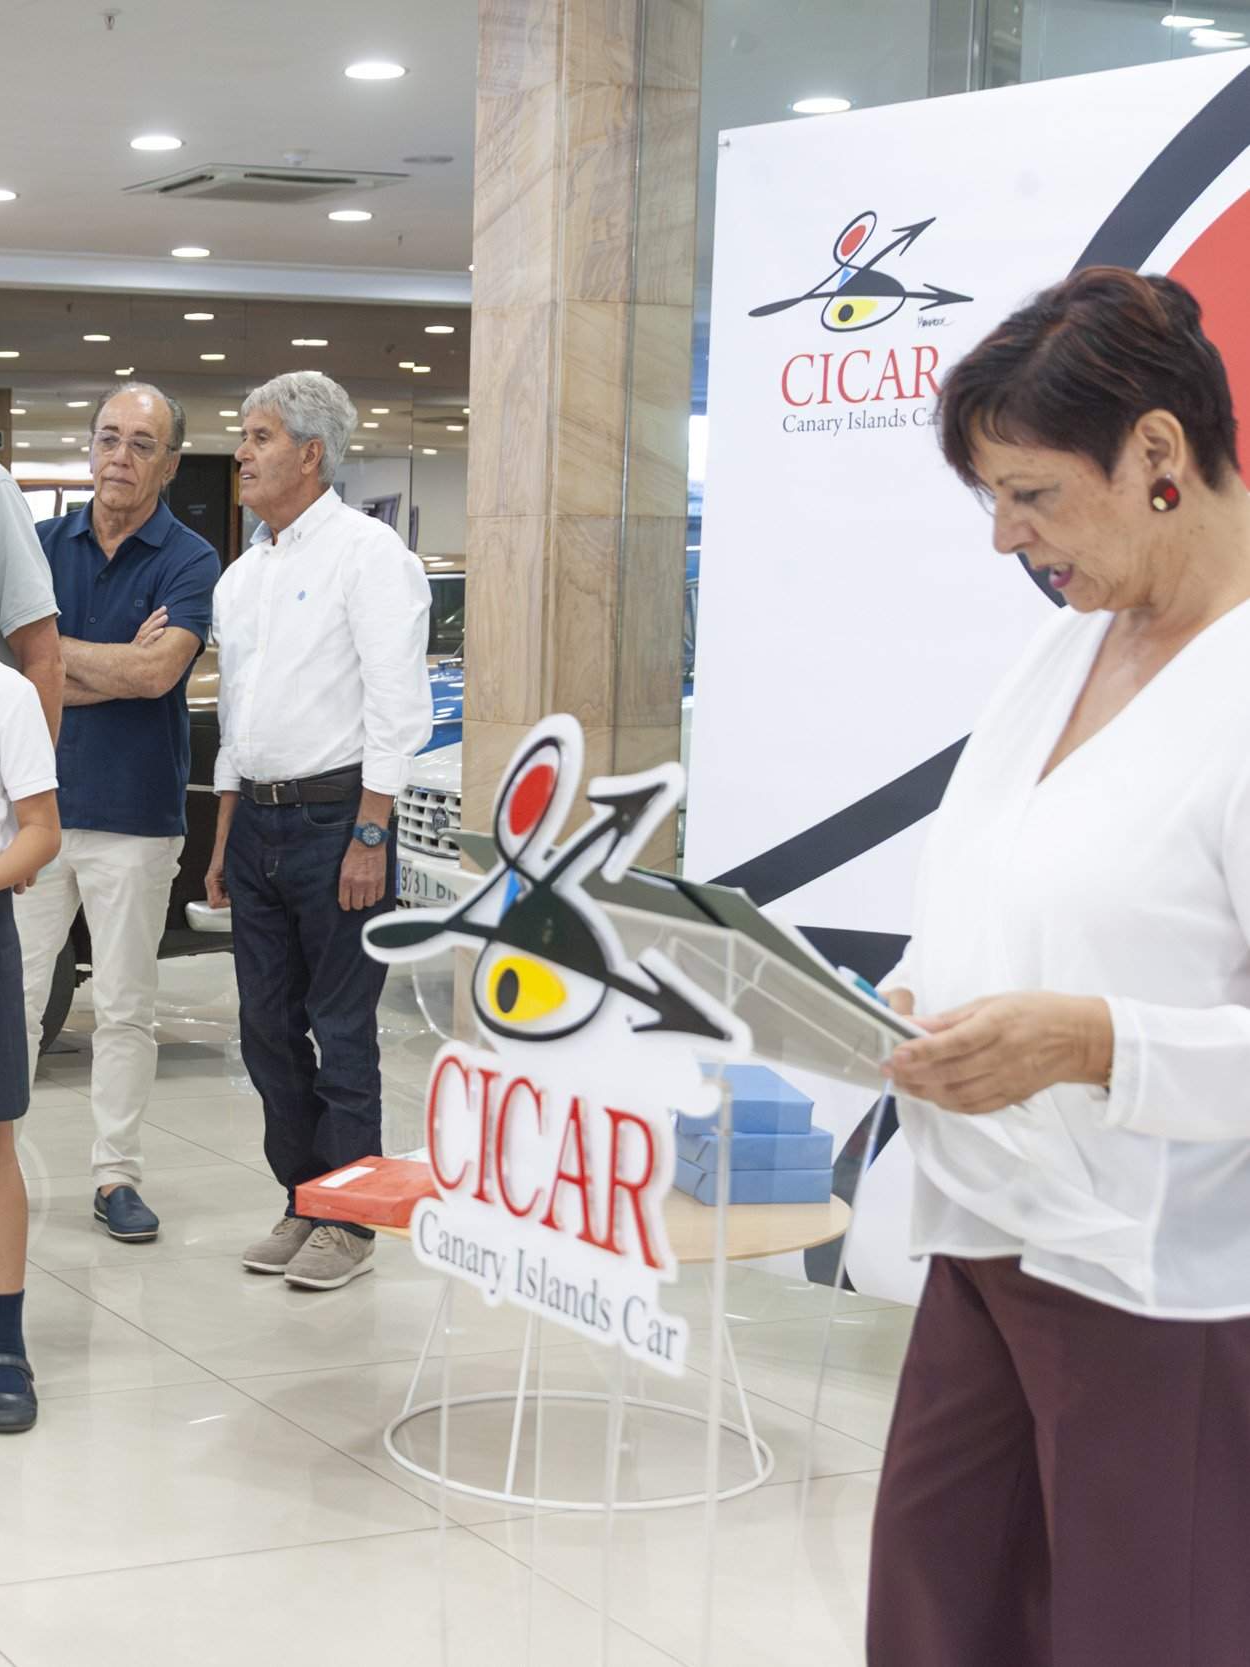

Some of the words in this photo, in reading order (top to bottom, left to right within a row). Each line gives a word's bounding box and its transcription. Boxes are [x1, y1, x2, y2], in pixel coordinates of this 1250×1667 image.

[781, 345, 942, 407] CICAR
[782, 414, 843, 437] Canary
[847, 408, 907, 430] Islands
[912, 407, 941, 427] Ca
[427, 1056, 664, 1270] CICAR
[418, 1210, 507, 1295] Canary
[515, 1249, 612, 1332] Islands
[622, 1295, 679, 1361] Car
